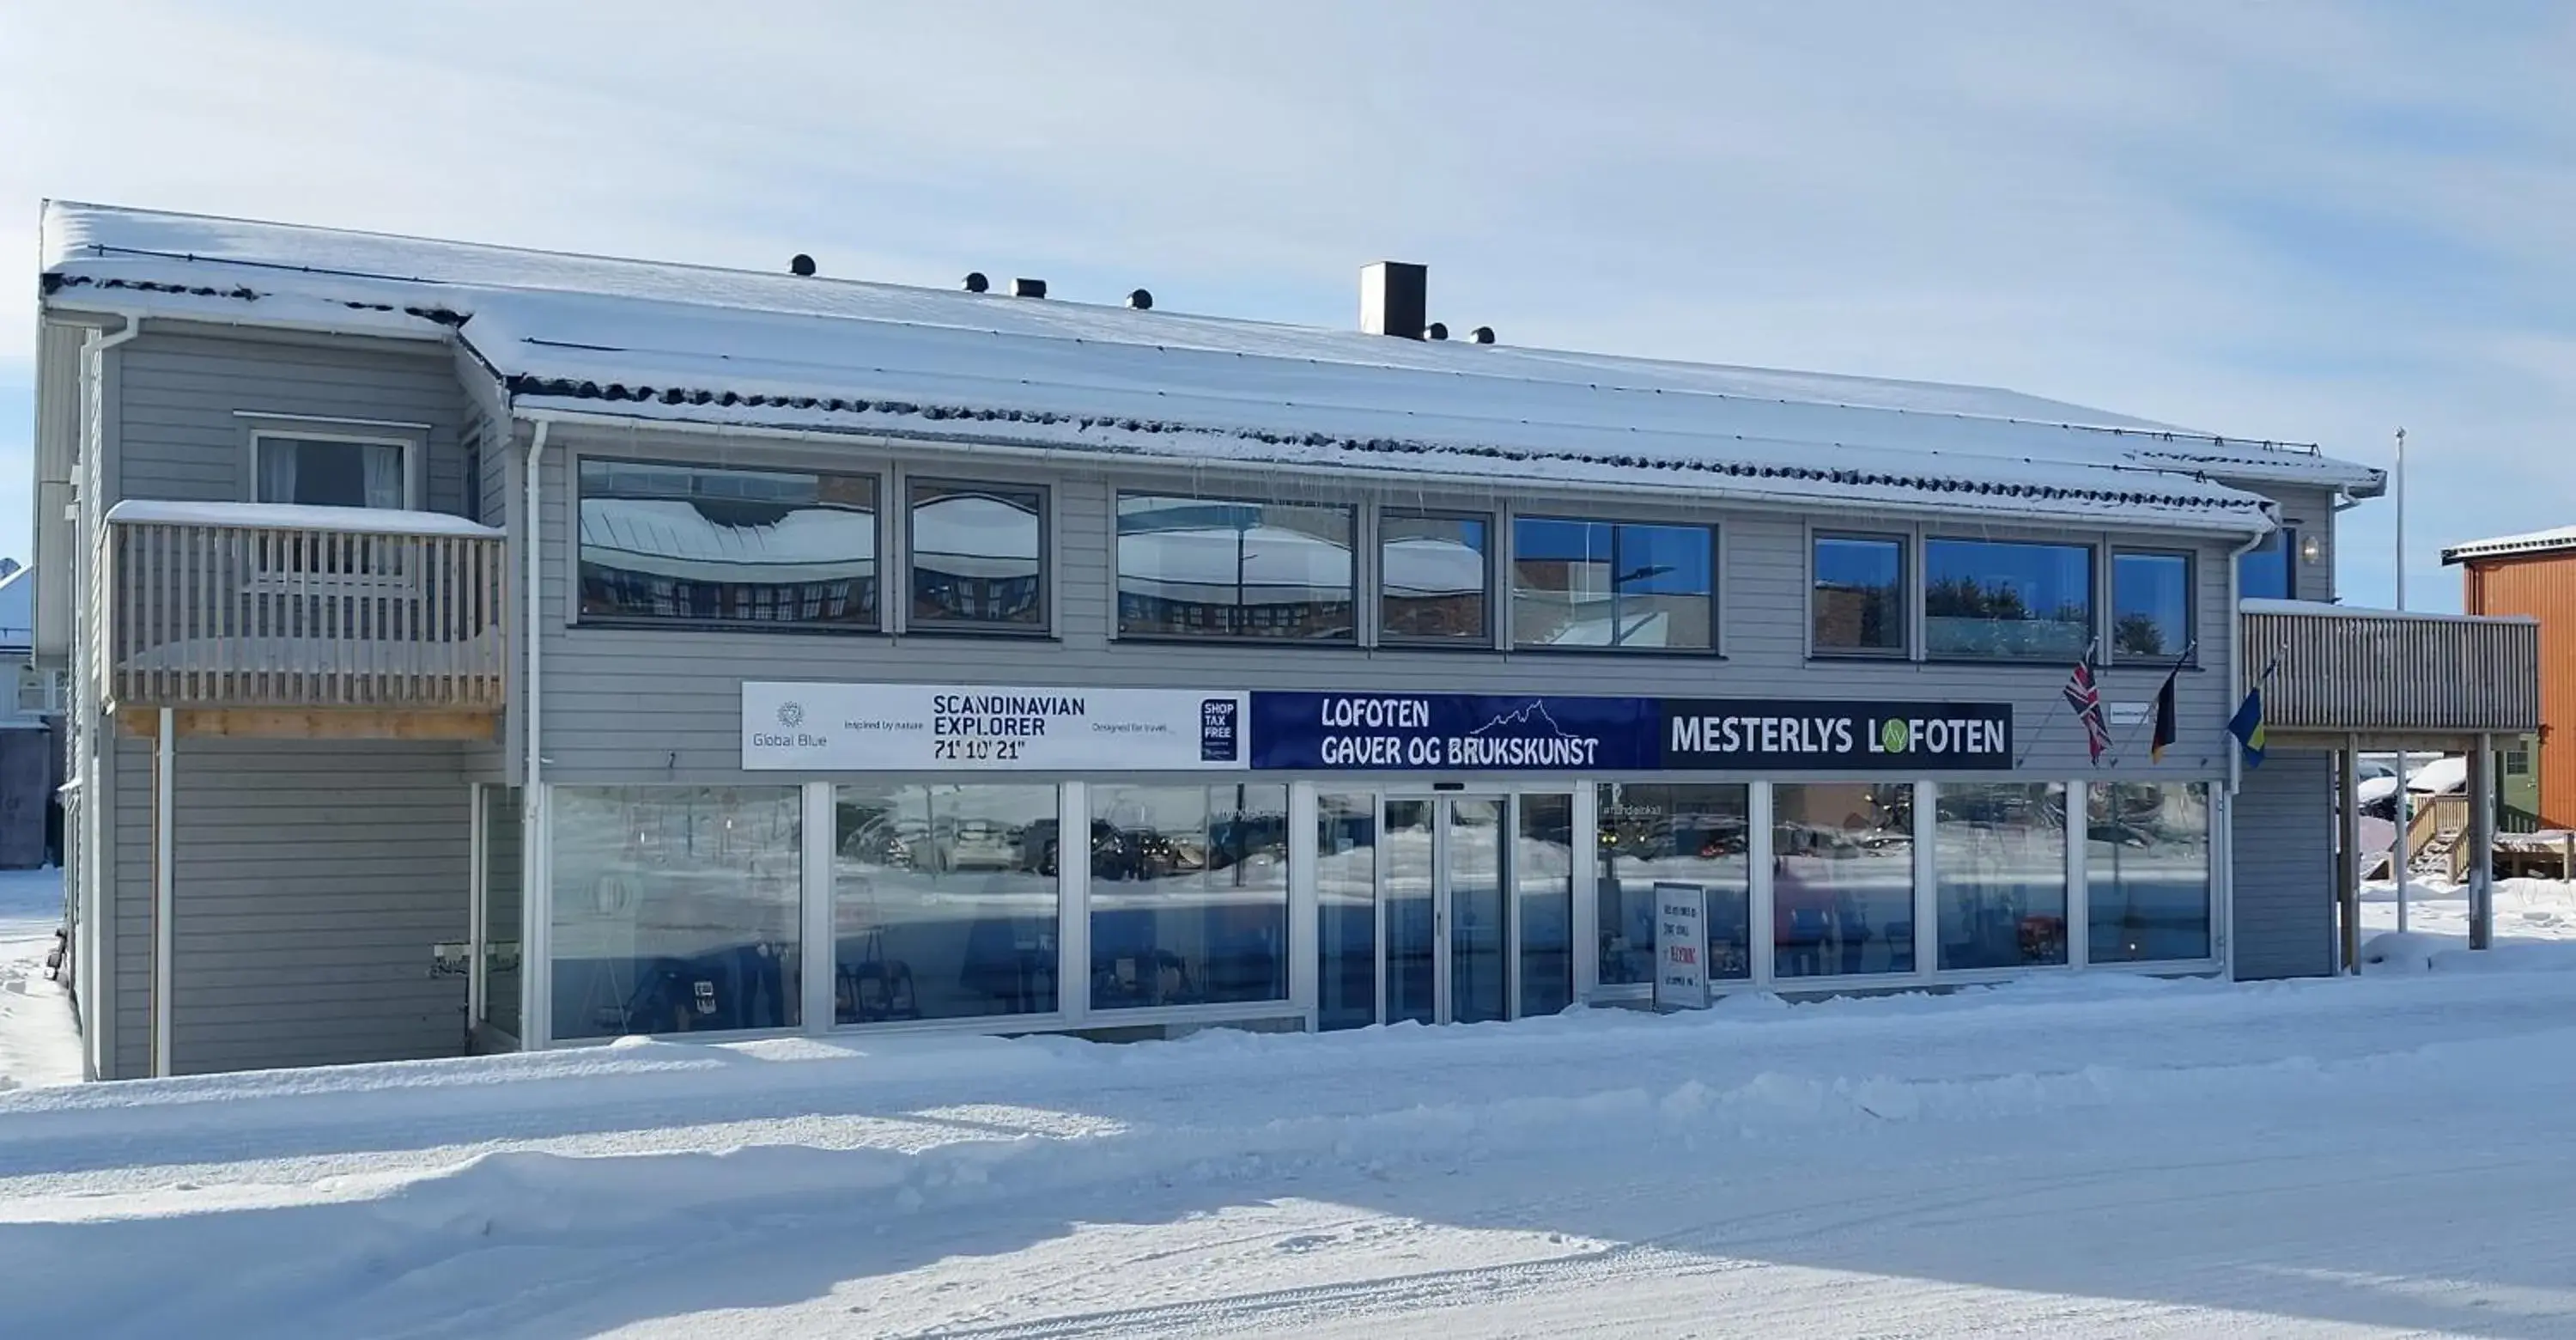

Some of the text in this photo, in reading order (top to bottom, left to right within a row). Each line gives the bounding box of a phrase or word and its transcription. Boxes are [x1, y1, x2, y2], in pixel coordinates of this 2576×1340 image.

[933, 695, 1085, 716] SCANDINAVIAN
[1204, 704, 1234, 714] SHOP
[1321, 698, 1430, 728] LOFOTEN
[844, 719, 880, 731] Inspired
[934, 716, 1045, 736] EXPLORER
[1204, 715, 1226, 726] TAX
[753, 733, 828, 747] Global Blue
[1204, 727, 1231, 738] FREE
[1671, 716, 2005, 753] MESTERLYS LOFOTEN
[1321, 736, 1599, 765] GAVER OG BRUKSKUNST
